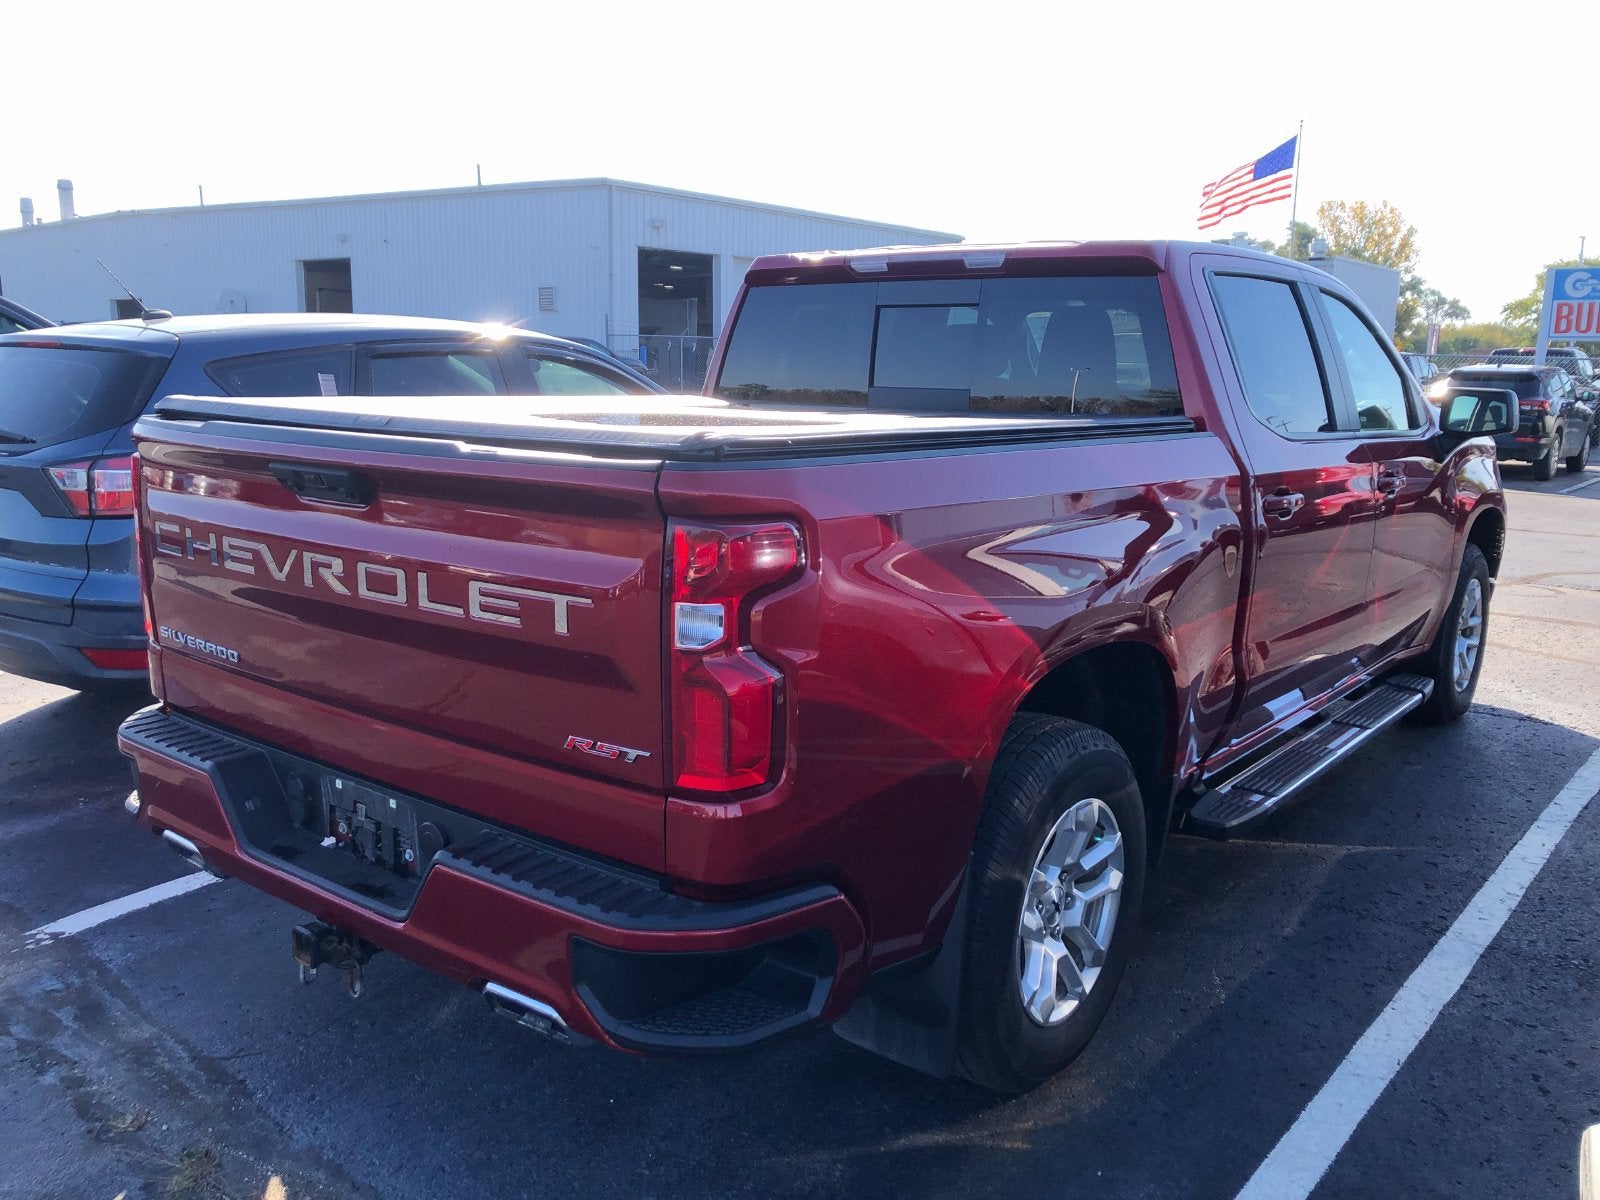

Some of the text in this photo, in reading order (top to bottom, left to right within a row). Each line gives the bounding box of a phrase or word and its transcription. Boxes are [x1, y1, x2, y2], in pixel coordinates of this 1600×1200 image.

[154, 520, 594, 637] CHEVROLET
[159, 625, 240, 663] SILVERADO
[563, 734, 651, 763] RST
